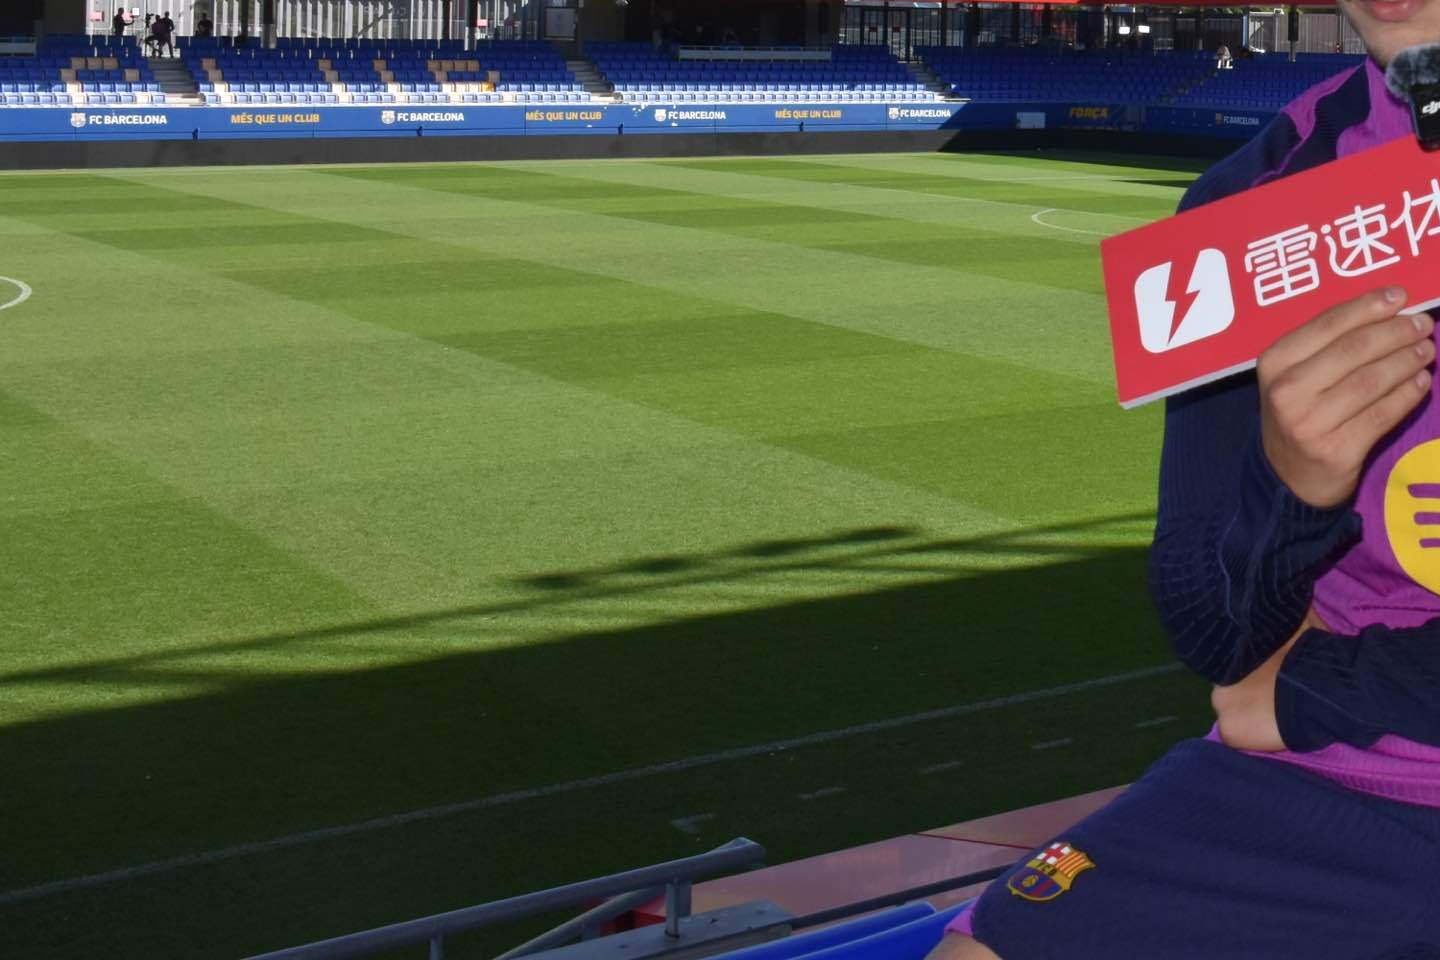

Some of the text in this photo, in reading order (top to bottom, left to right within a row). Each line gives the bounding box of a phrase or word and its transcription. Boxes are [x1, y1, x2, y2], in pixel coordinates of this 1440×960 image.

[230, 112, 320, 124] MÉS QUE UN CLUB
[397, 112, 465, 122] FC BARCELONA
[525, 110, 602, 121] MÉS QUE UN CLUB
[668, 111, 726, 120] FC BARCELONA
[793, 110, 809, 119] QUE
[900, 109, 951, 118] FC BARCELONA
[89, 114, 168, 125] FC BARCELONA
